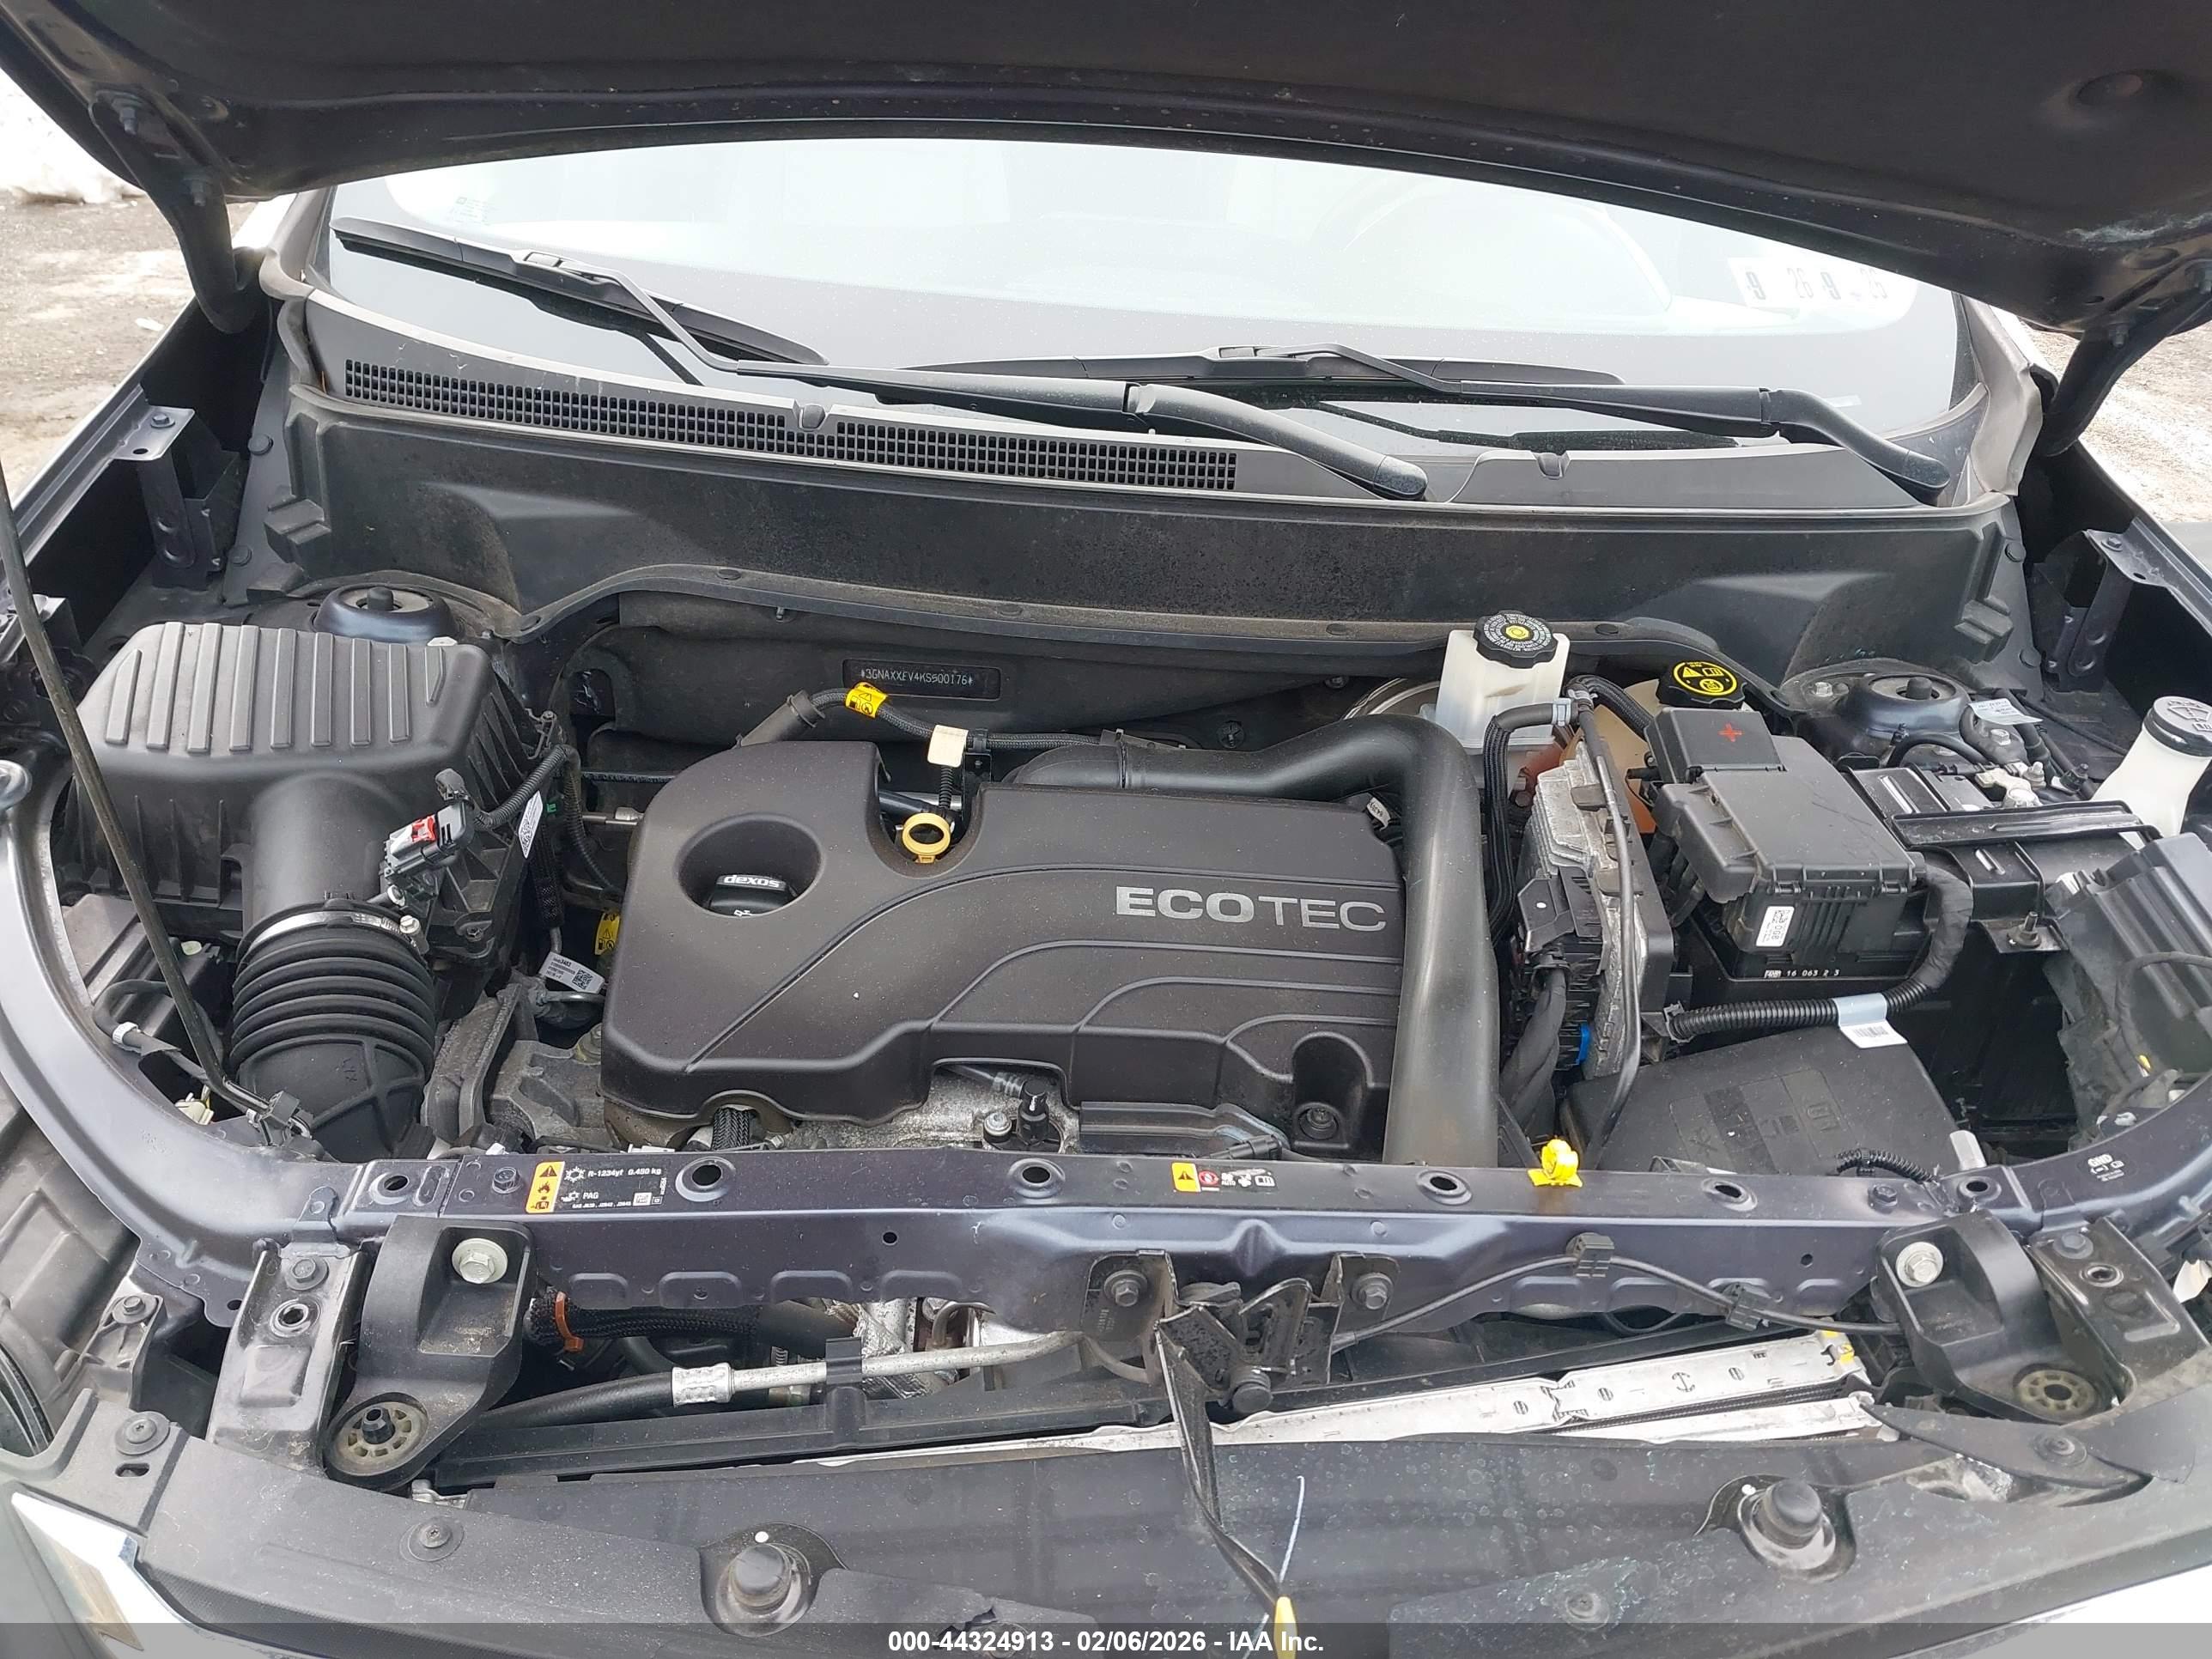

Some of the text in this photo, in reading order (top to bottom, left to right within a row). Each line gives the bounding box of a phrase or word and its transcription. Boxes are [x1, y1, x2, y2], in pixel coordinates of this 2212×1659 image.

[723, 874, 781, 888] dexos
[1115, 885, 1388, 933] ECOTEC
[582, 1191, 599, 1200] PAG
